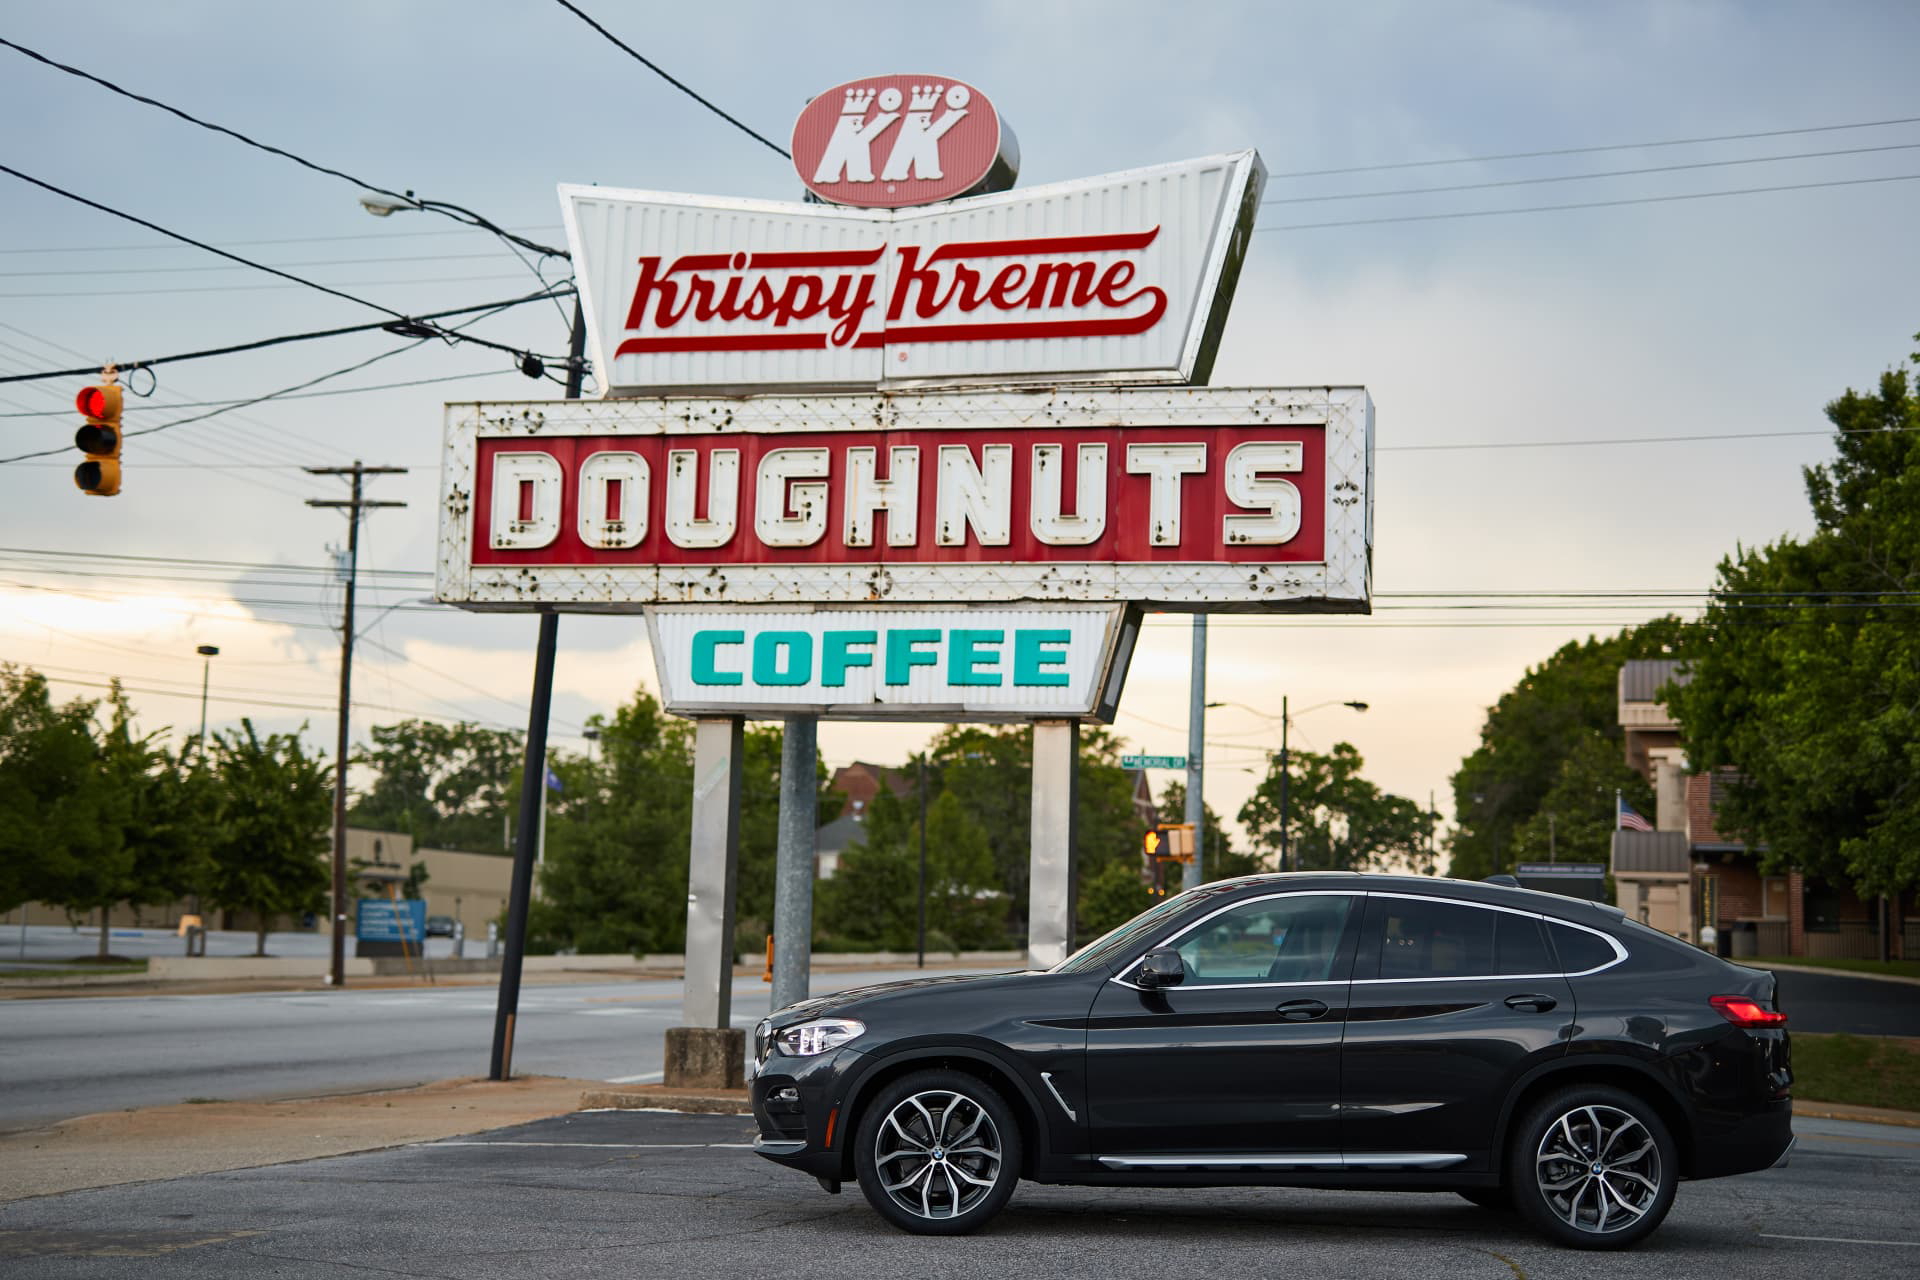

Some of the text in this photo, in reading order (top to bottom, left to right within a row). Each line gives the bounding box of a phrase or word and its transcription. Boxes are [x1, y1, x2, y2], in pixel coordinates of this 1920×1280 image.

[622, 226, 1168, 349] Krispy Kreme
[488, 440, 1304, 550] DOUGHNUTS
[691, 629, 1073, 687] COFFEE
